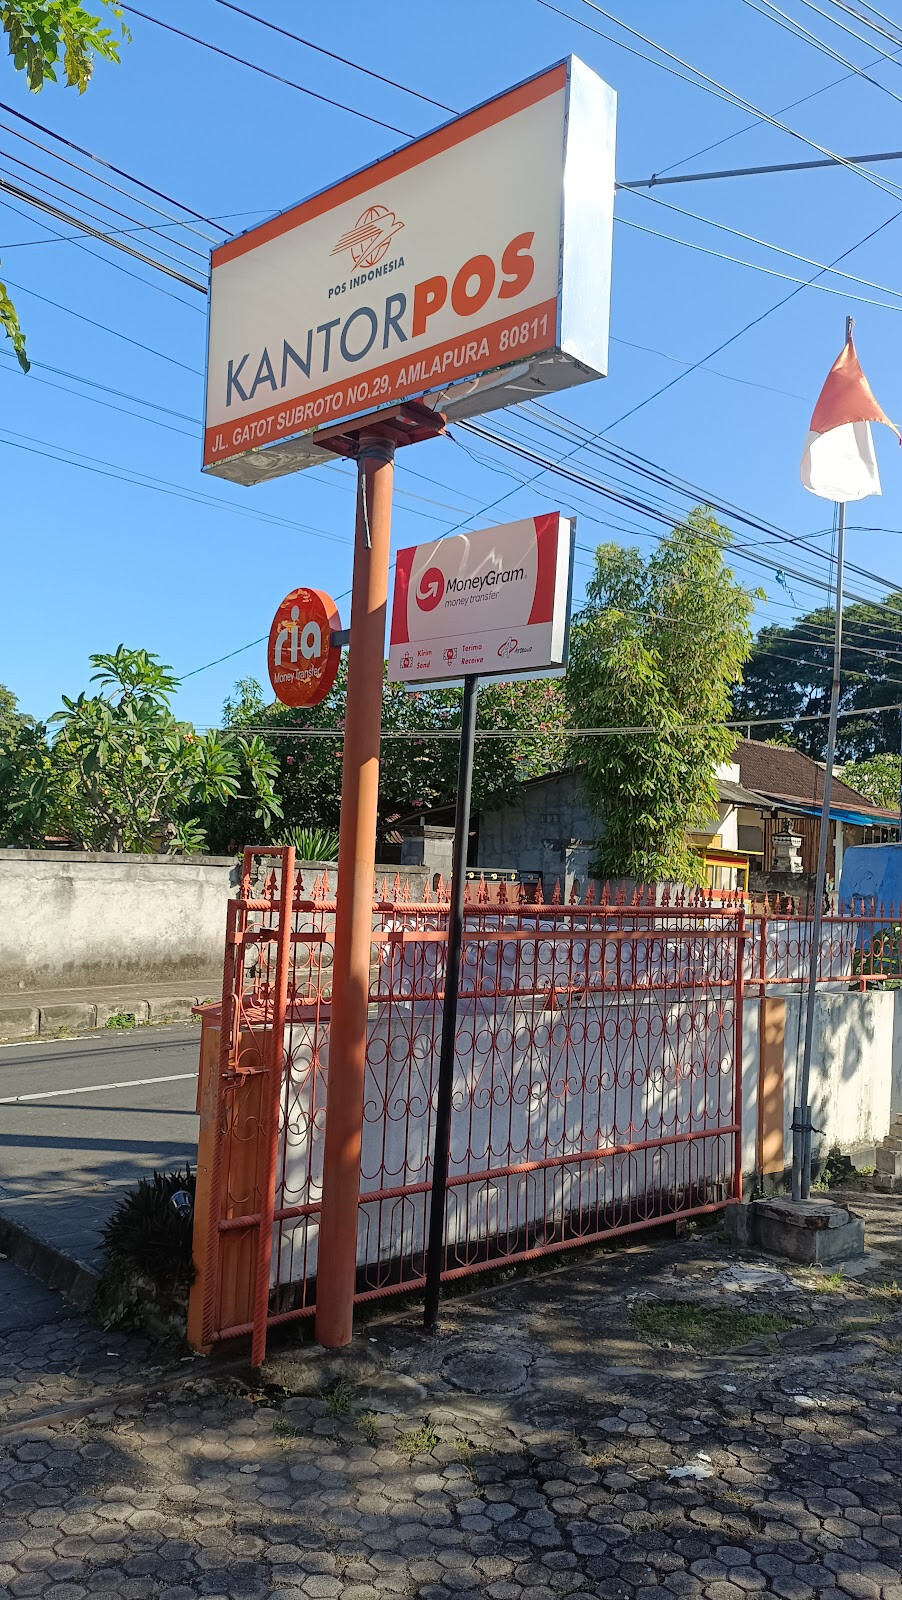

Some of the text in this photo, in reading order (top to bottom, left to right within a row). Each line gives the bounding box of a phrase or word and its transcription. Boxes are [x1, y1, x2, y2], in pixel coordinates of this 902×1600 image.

[328, 256, 405, 299] POS INDONESIA
[211, 314, 549, 453] JL. GATOT SUBROTO NO.29, AMLAPURA 80811
[446, 567, 526, 594] MoneyGram
[444, 590, 501, 608] money transfer
[274, 605, 322, 667] ria
[417, 648, 432, 657] Kirim
[462, 643, 483, 652] Terima
[416, 660, 431, 669] Send
[461, 655, 484, 665] Receive
[274, 667, 321, 683] Money Transfer
